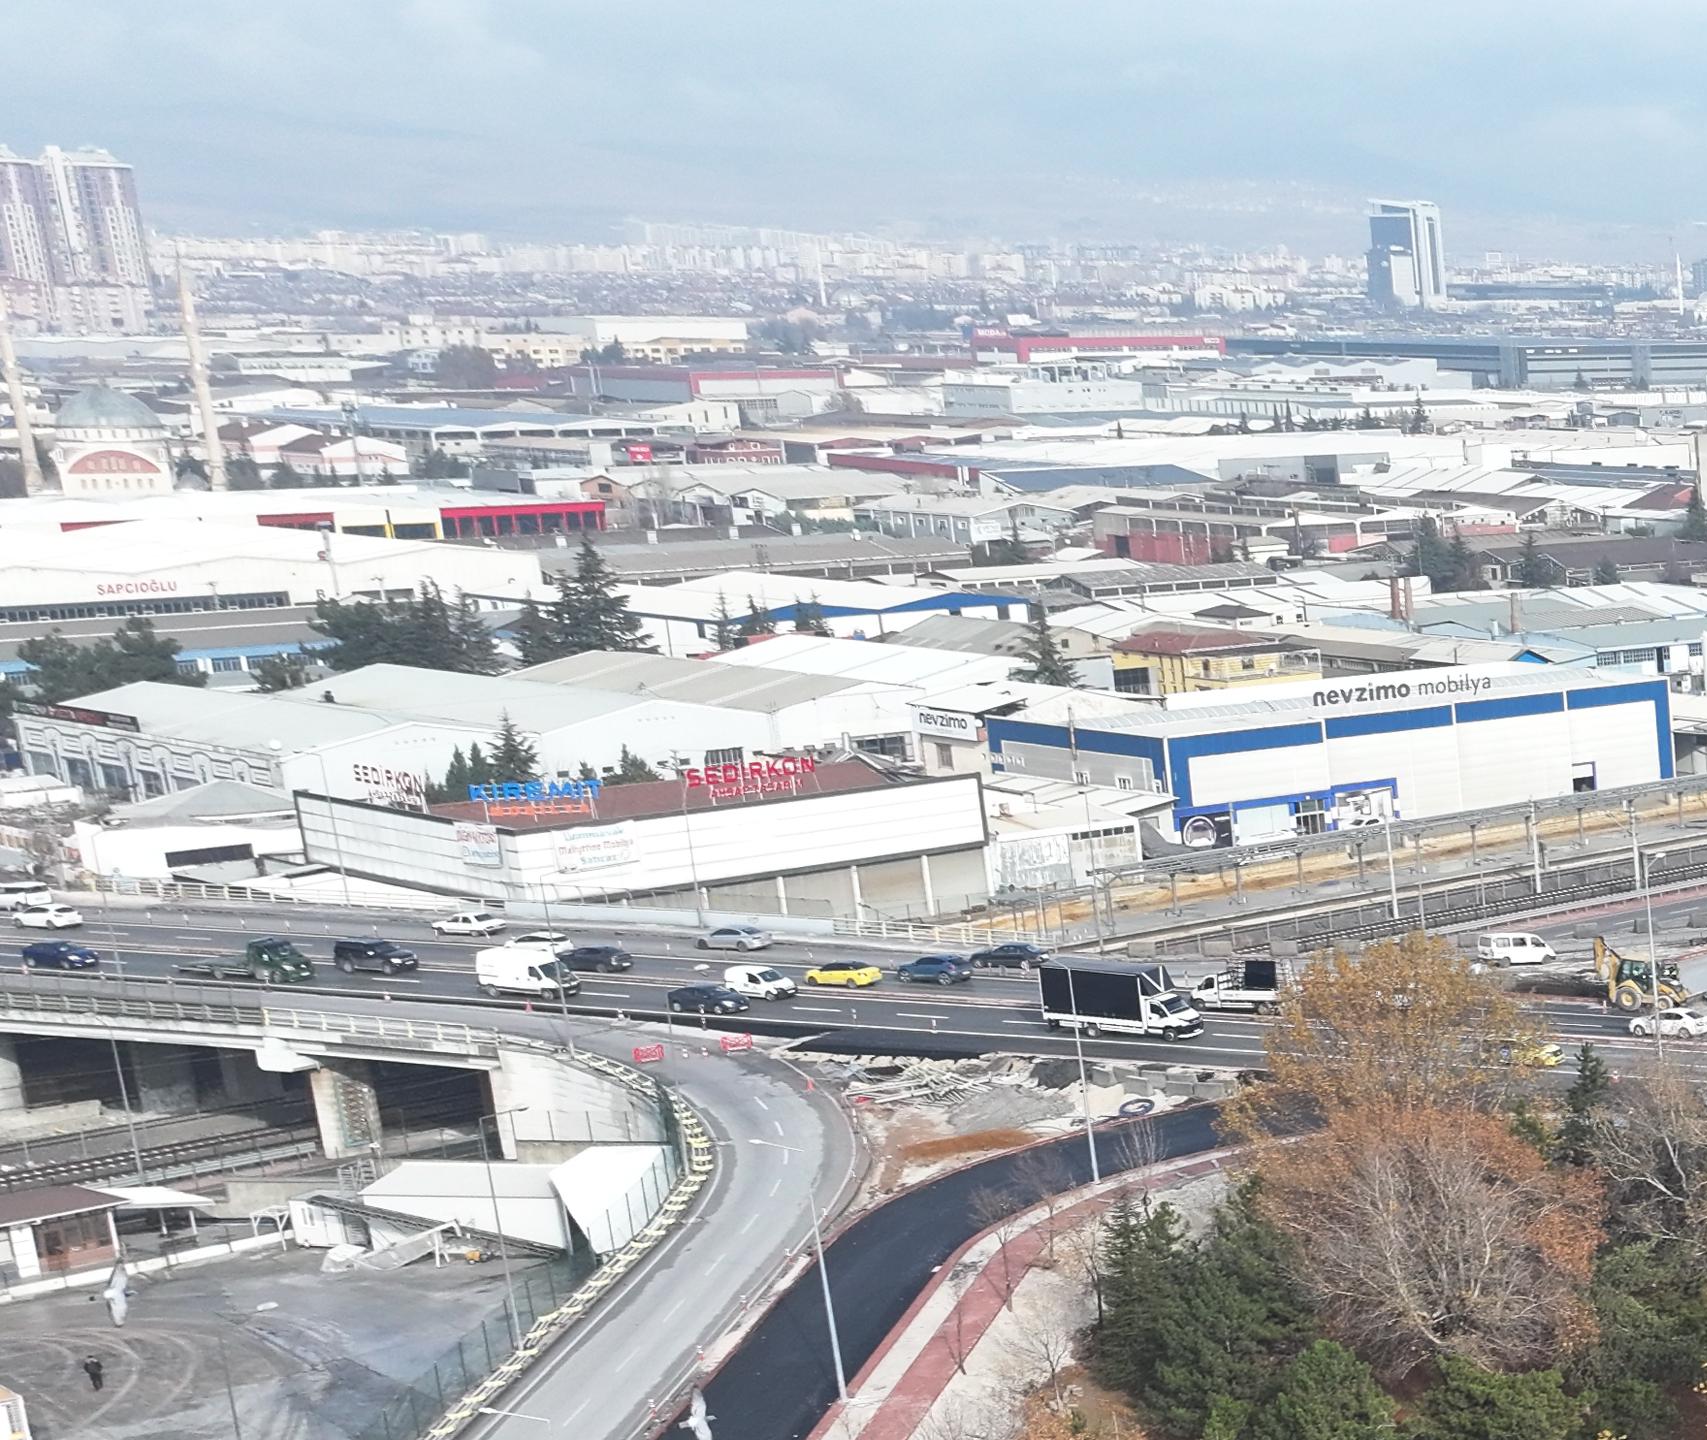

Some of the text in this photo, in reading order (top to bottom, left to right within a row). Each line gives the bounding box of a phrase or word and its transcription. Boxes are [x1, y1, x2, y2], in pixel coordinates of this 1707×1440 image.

[1312, 673, 1492, 707] nevzimo mobilya
[919, 712, 968, 730] nevzimo
